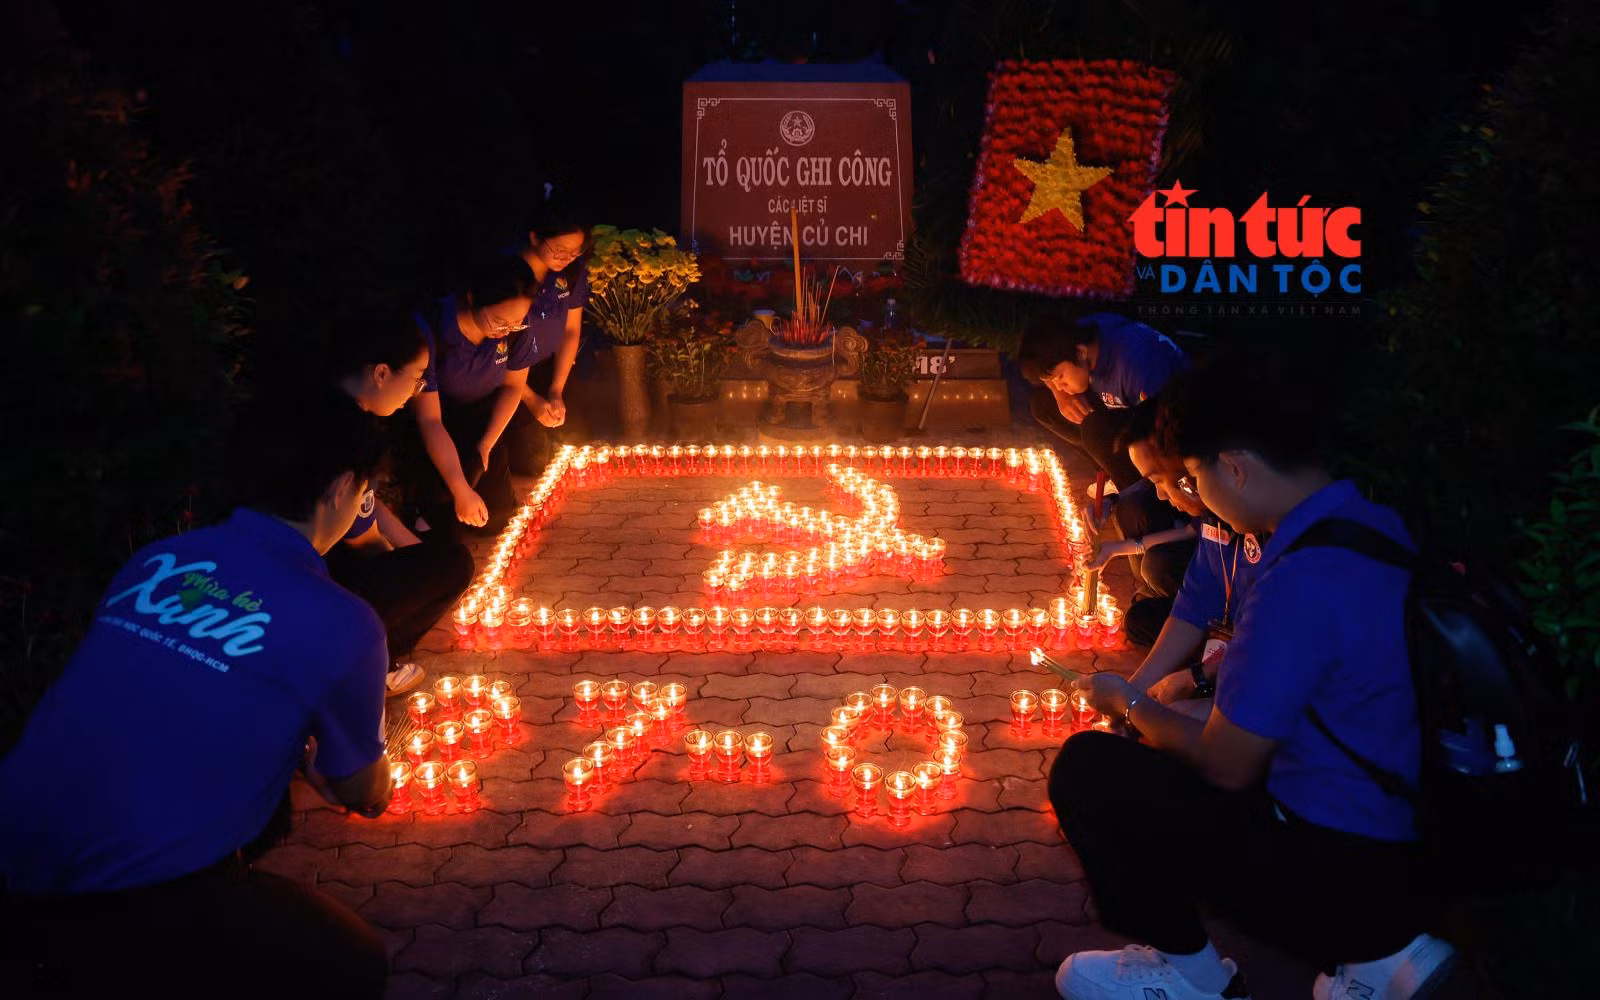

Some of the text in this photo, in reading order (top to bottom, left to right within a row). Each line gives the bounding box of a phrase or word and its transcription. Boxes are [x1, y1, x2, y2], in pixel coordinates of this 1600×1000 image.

[702, 138, 892, 192] TỔ QUỐC GHI CÔNG
[768, 195, 790, 213] CÁC
[802, 219, 829, 246] CỦ
[835, 225, 868, 246] CHI
